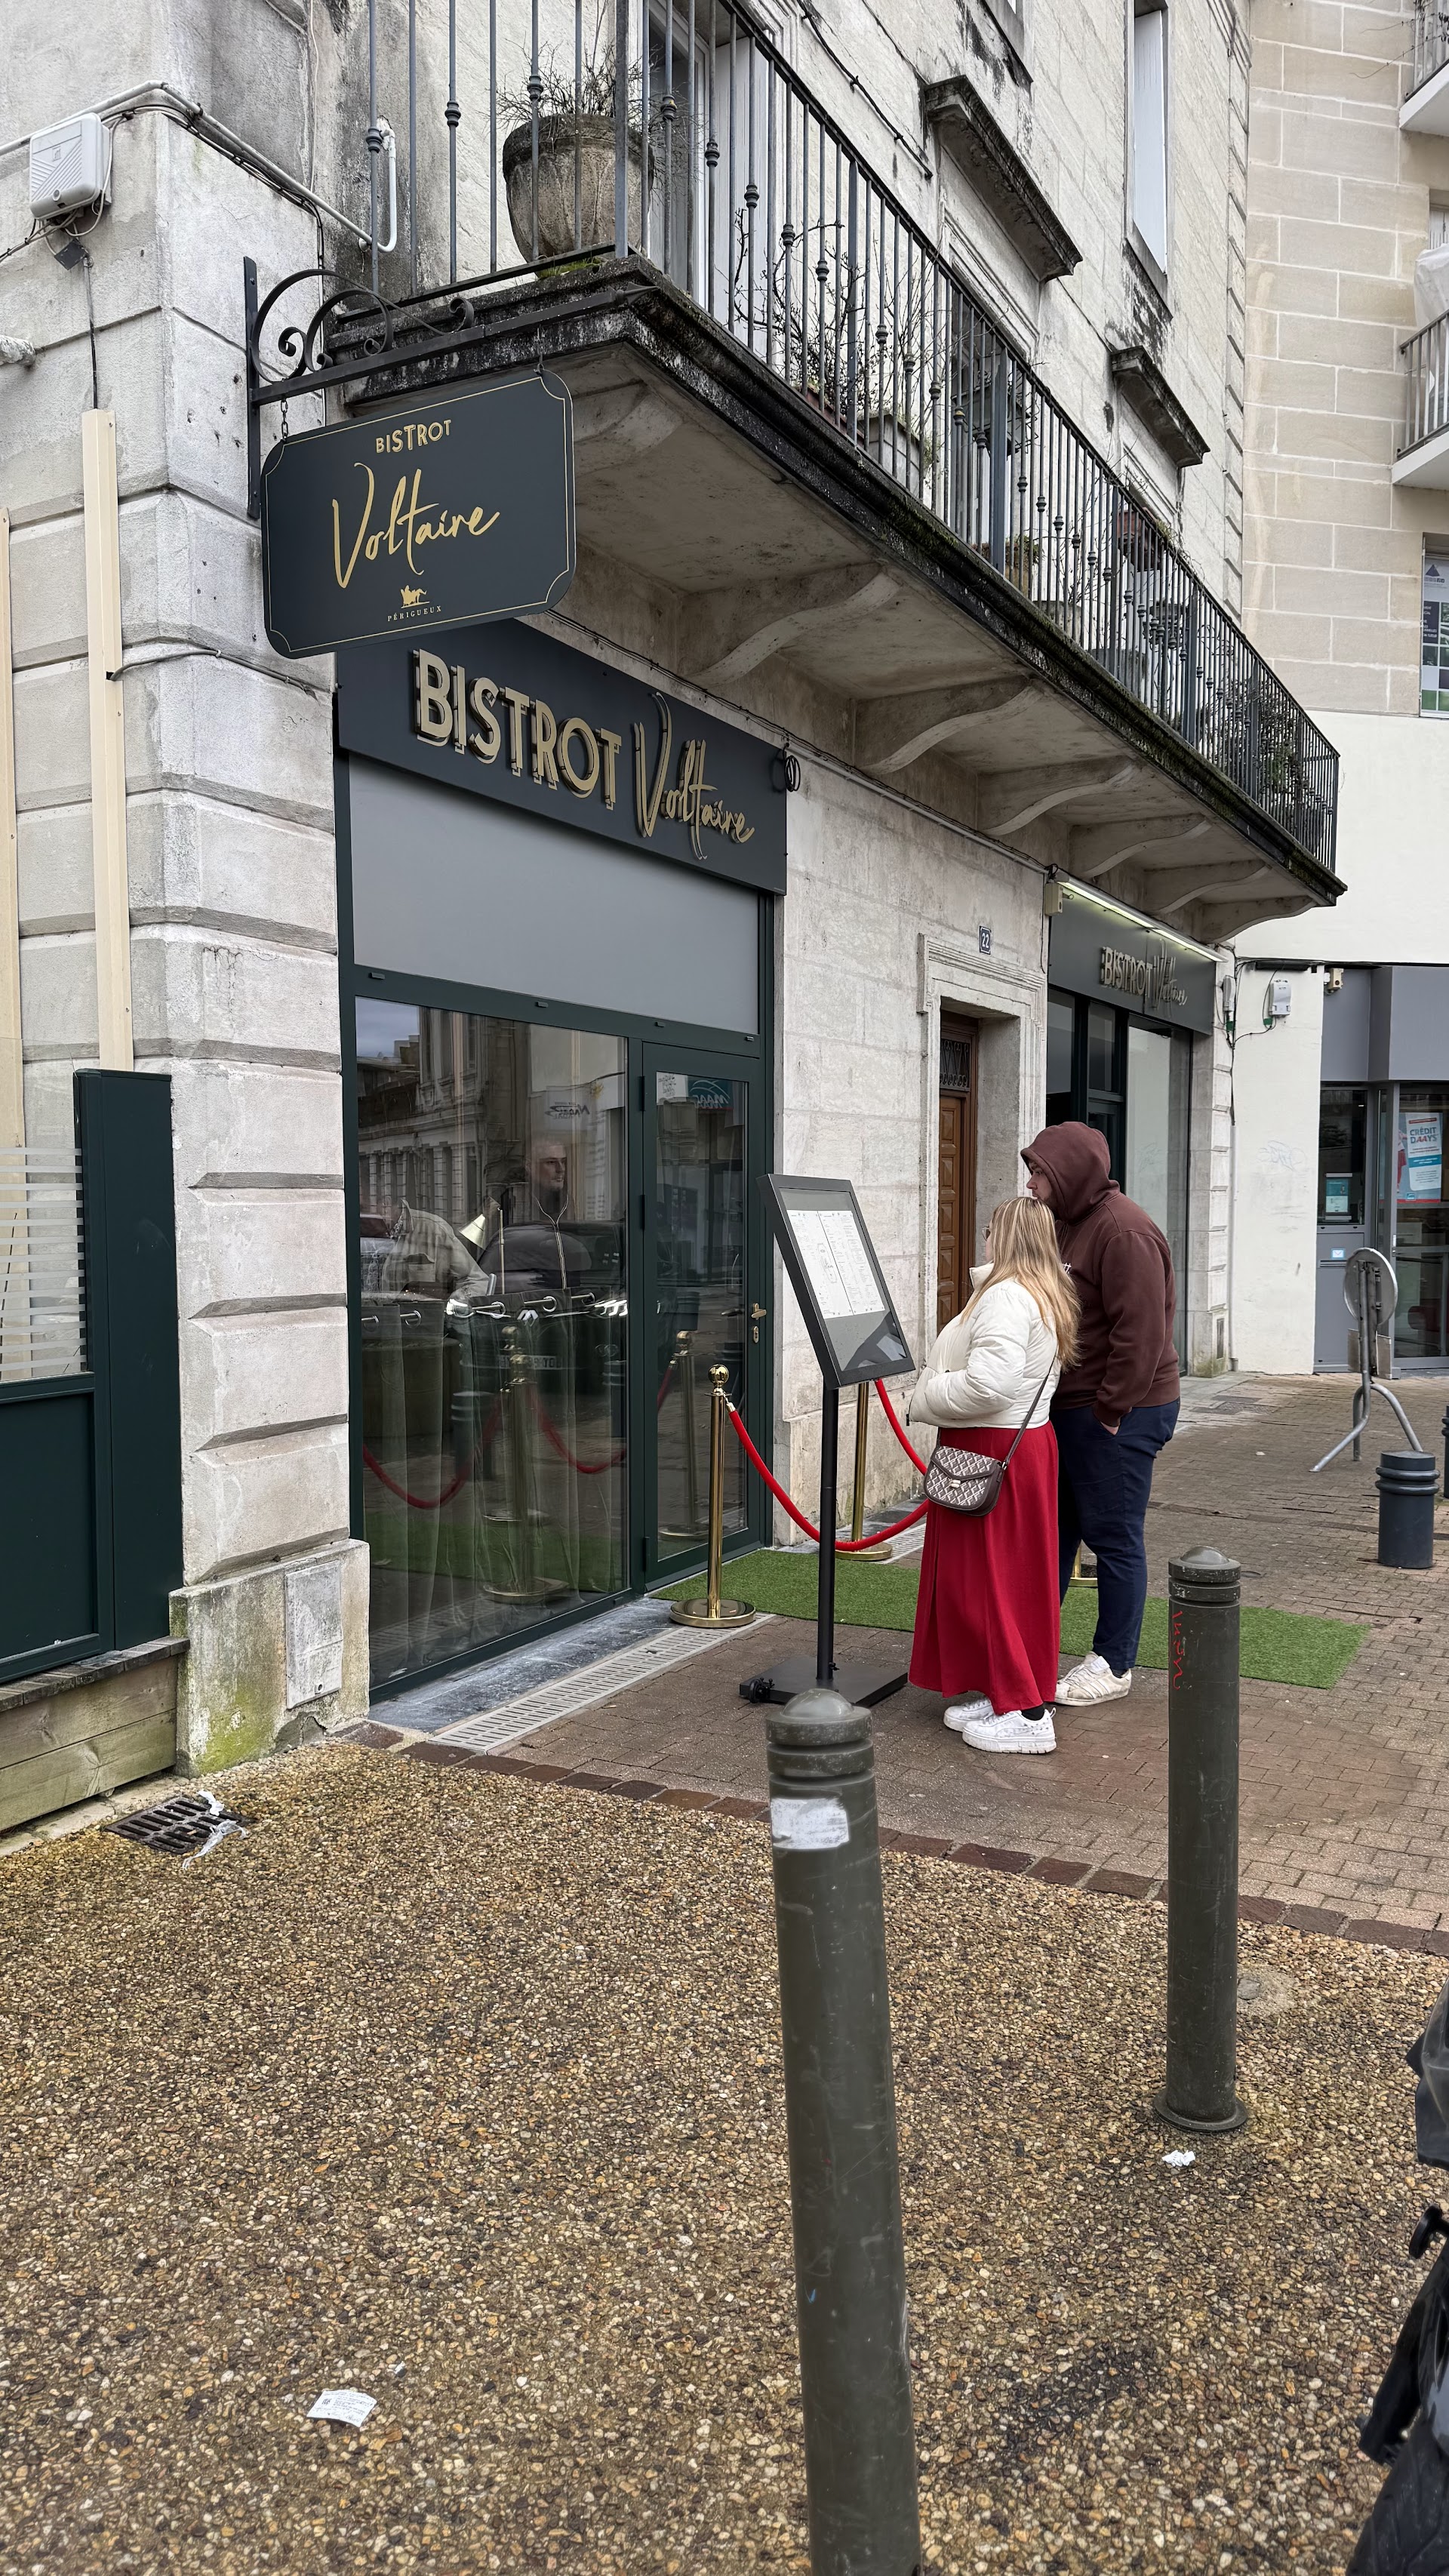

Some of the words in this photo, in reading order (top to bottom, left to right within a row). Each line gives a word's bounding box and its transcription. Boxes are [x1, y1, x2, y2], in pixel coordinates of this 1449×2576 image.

[376, 419, 451, 453] BISTROT
[332, 462, 500, 589] Voltaire
[387, 605, 441, 622] PÉRIGUEUX
[415, 648, 622, 810] BISTROT
[634, 691, 755, 860] Voltaire
[982, 932, 989, 949] 22
[1102, 946, 1153, 999] BISTROT
[1410, 1127, 1437, 1137] CRÉDIT
[1410, 1134, 1438, 1144] DAAYS
